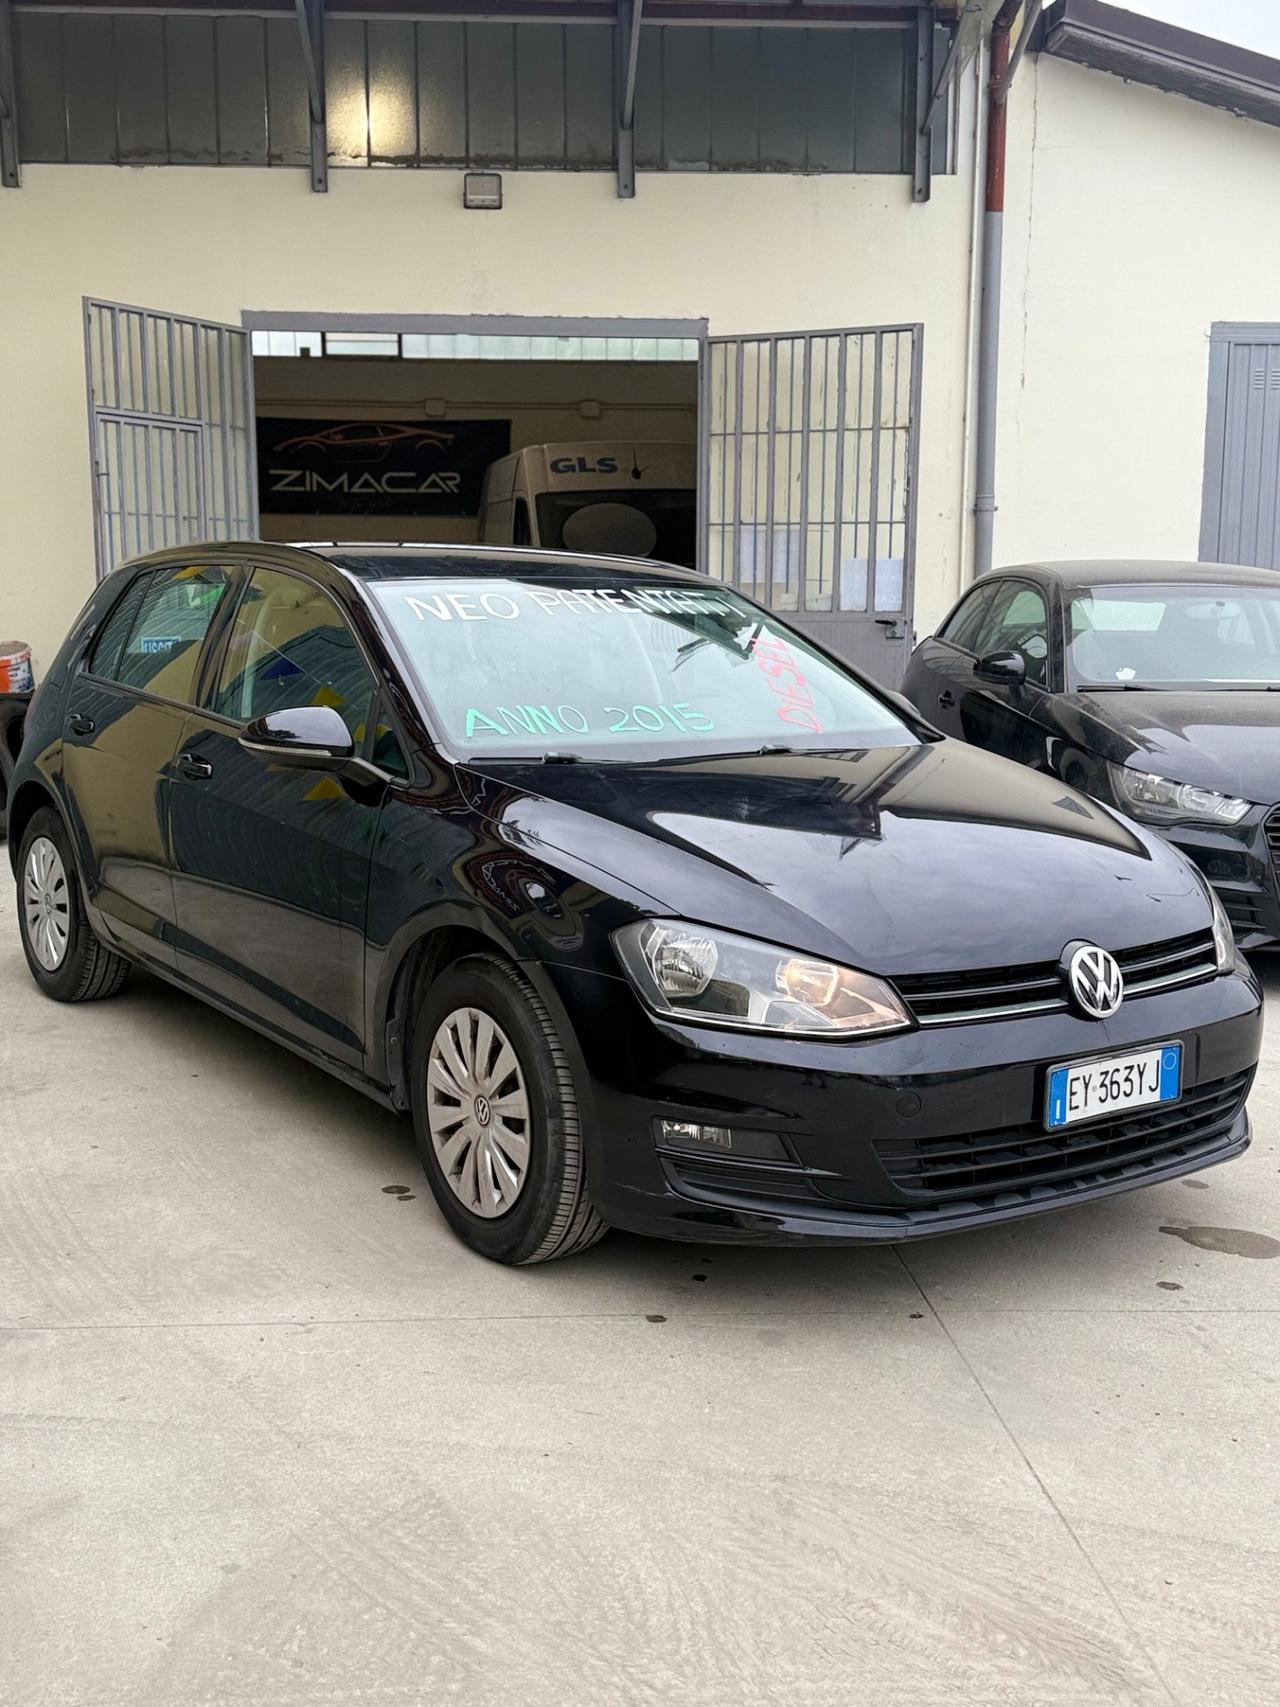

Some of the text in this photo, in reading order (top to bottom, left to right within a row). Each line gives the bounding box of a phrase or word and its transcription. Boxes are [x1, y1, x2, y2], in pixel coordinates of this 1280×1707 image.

[268, 469, 461, 493] ZIMACAR
[550, 457, 618, 473] GLS
[403, 589, 746, 621] NEO PATENTATI
[750, 637, 823, 734] DIESEL
[465, 702, 715, 737] ANNO 2015
